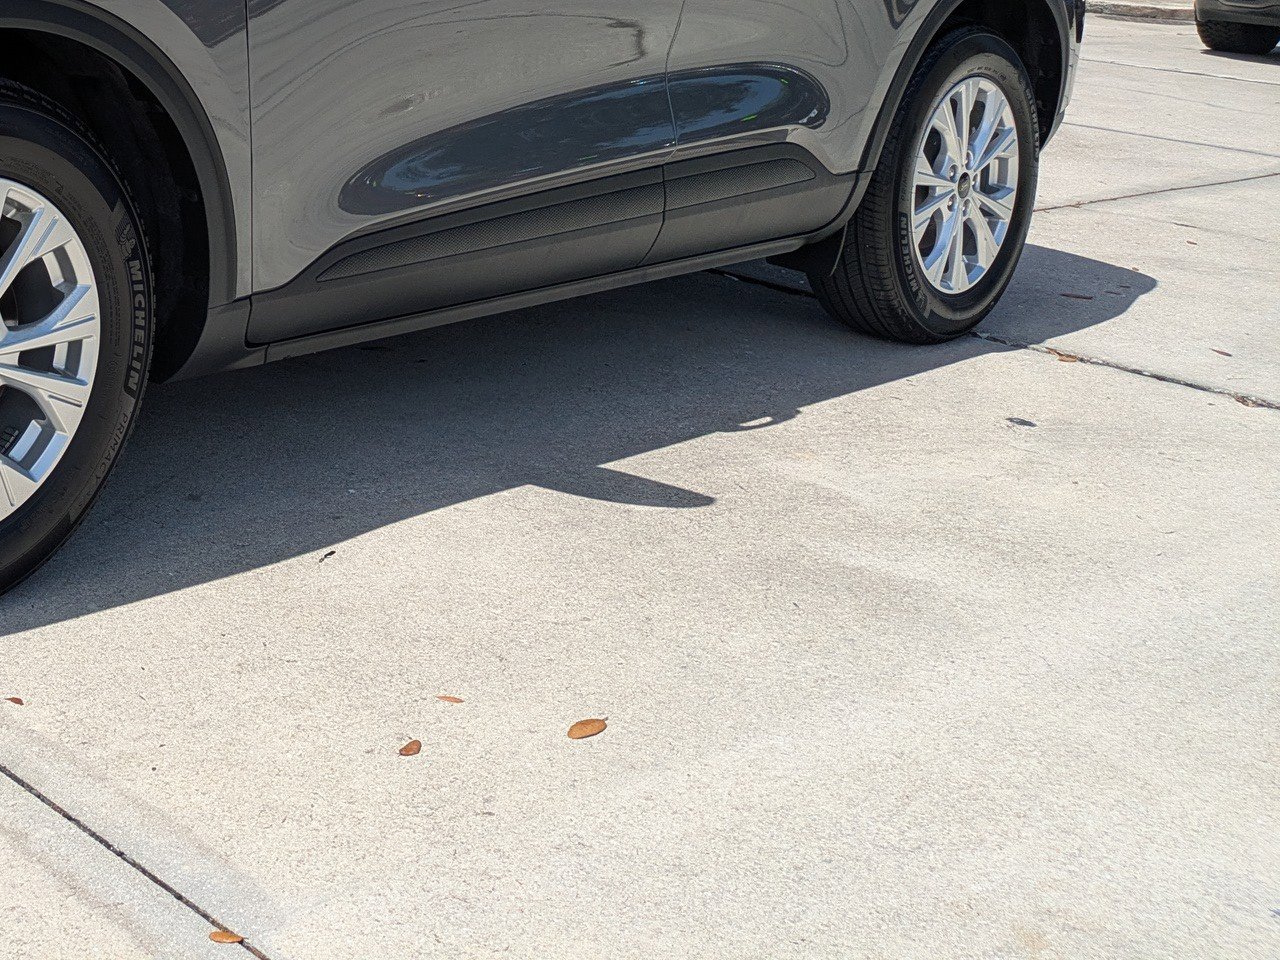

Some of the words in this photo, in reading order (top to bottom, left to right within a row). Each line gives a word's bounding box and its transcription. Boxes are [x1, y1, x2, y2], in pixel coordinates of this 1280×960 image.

[900, 216, 919, 292] MICHELIN
[129, 259, 147, 391] MICHELIN
[95, 412, 129, 480] PRIMACY
